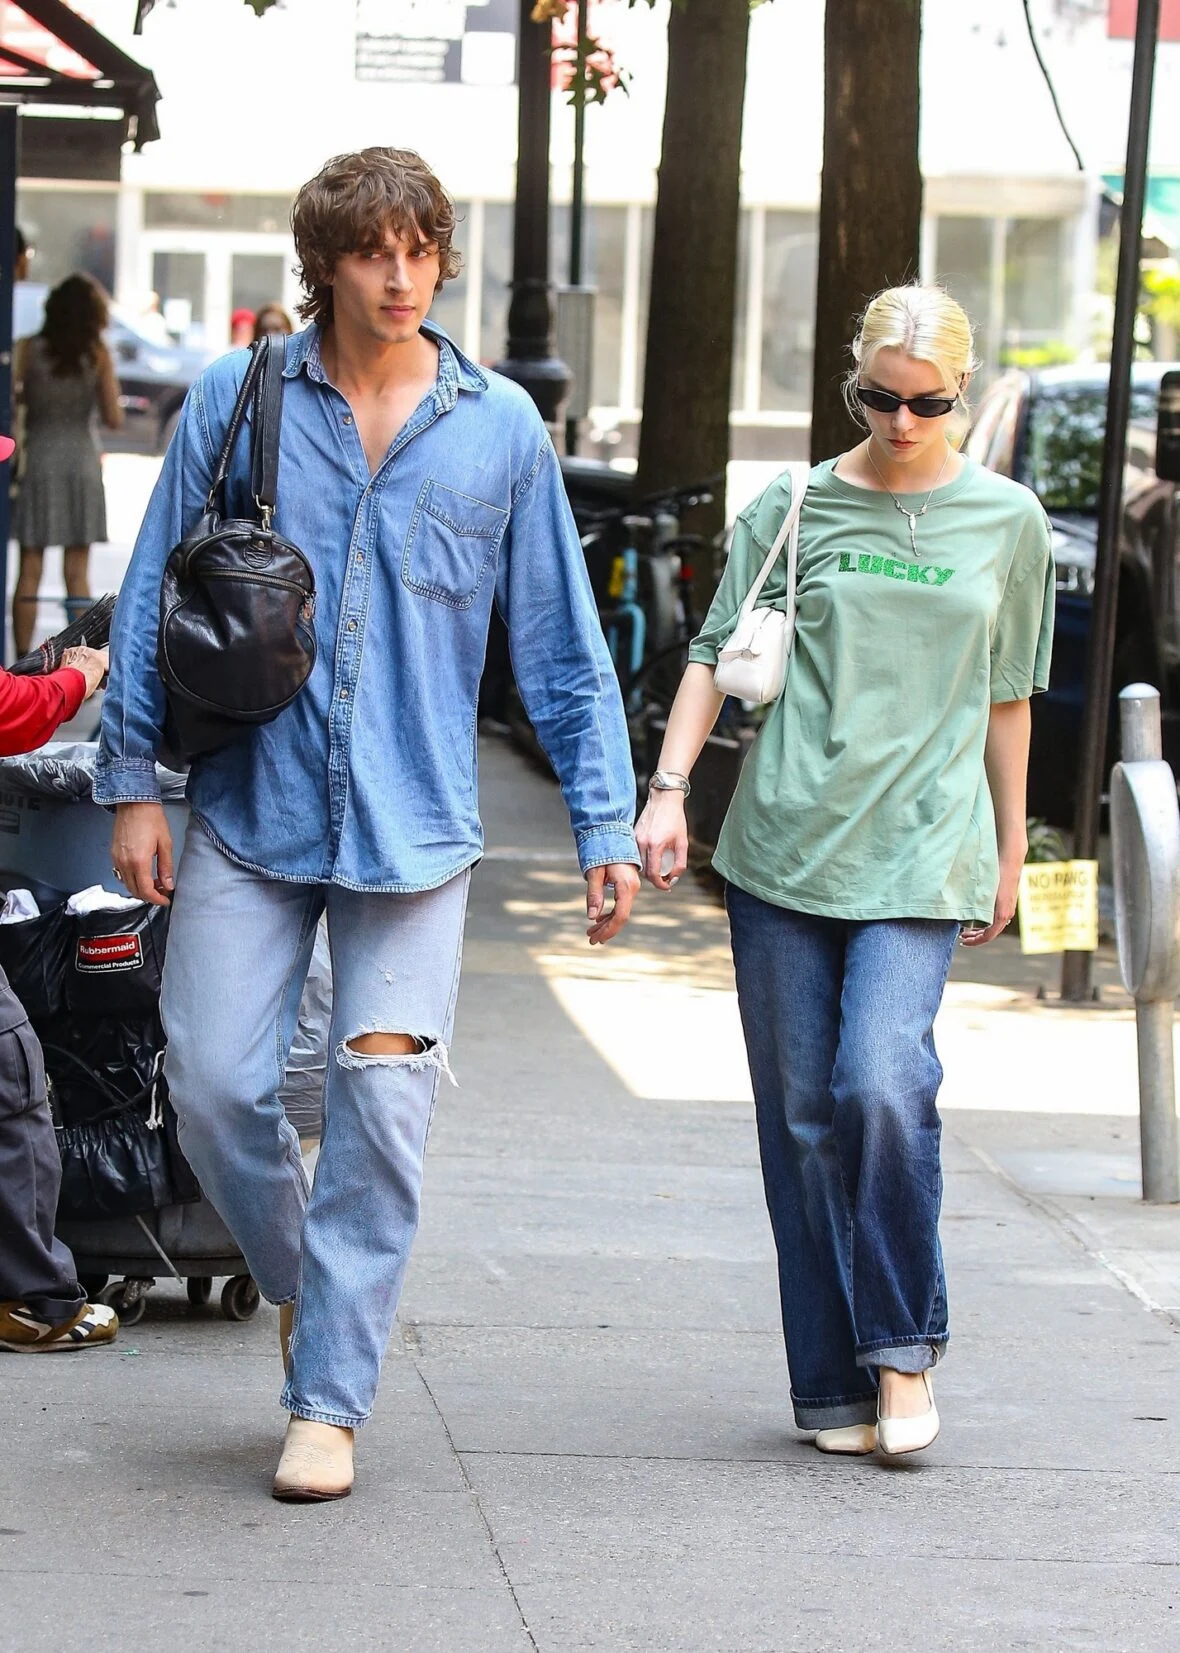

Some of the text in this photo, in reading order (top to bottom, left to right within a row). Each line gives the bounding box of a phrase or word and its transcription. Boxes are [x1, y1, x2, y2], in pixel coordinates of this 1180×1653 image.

[838, 552, 955, 586] LUCKY
[1028, 872, 1050, 889] NO
[80, 941, 136, 955] Rubbermaid
[78, 959, 140, 970] Commercial Products
